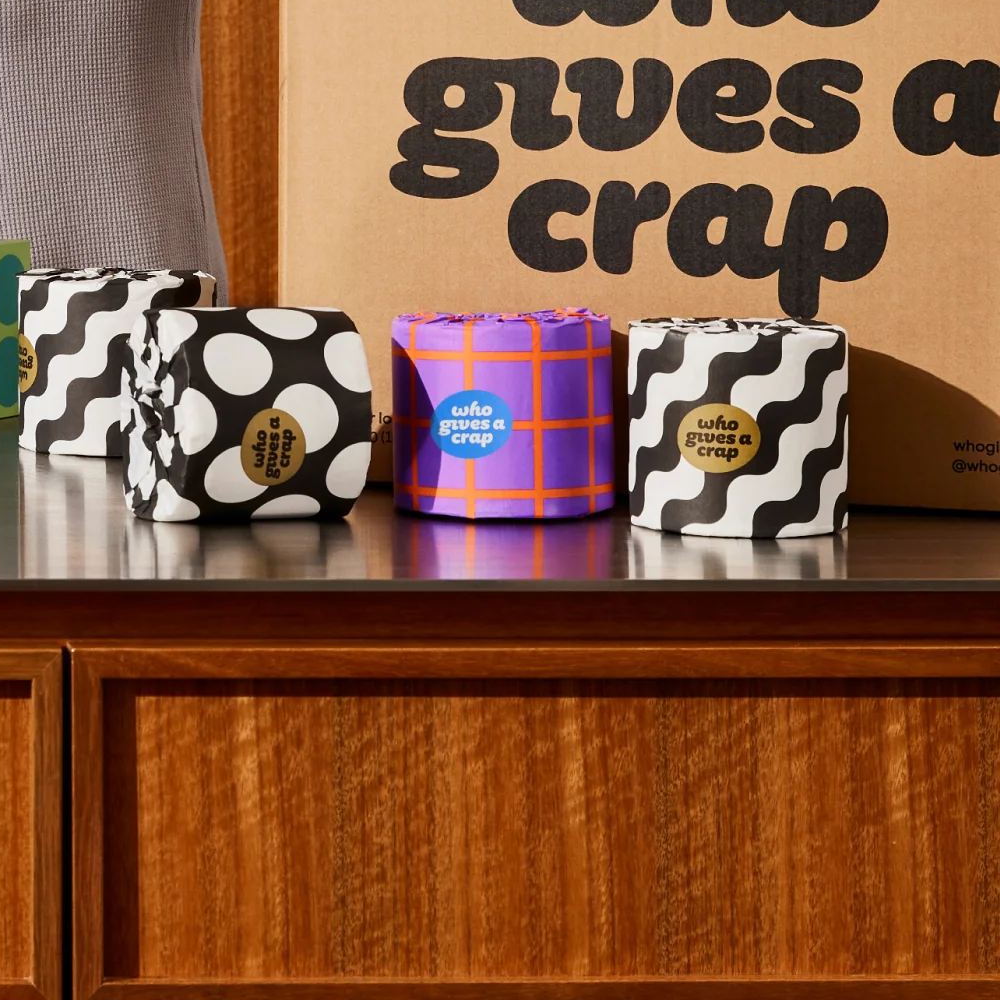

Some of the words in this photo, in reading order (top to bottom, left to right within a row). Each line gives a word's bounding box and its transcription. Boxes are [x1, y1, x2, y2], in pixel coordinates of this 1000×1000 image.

[389, 56, 864, 200] gives
[892, 59, 1000, 157] a
[507, 178, 889, 319] crap
[451, 400, 493, 417] who
[269, 416, 281, 430] a
[438, 418, 490, 436] gives
[492, 418, 506, 430] a
[697, 414, 739, 431] who
[451, 432, 494, 448] crap
[684, 431, 737, 447] gives
[738, 433, 753, 446] a
[252, 429, 268, 469] who
[265, 431, 281, 480] gives
[279, 428, 297, 469] crap
[696, 446, 739, 463] crap
